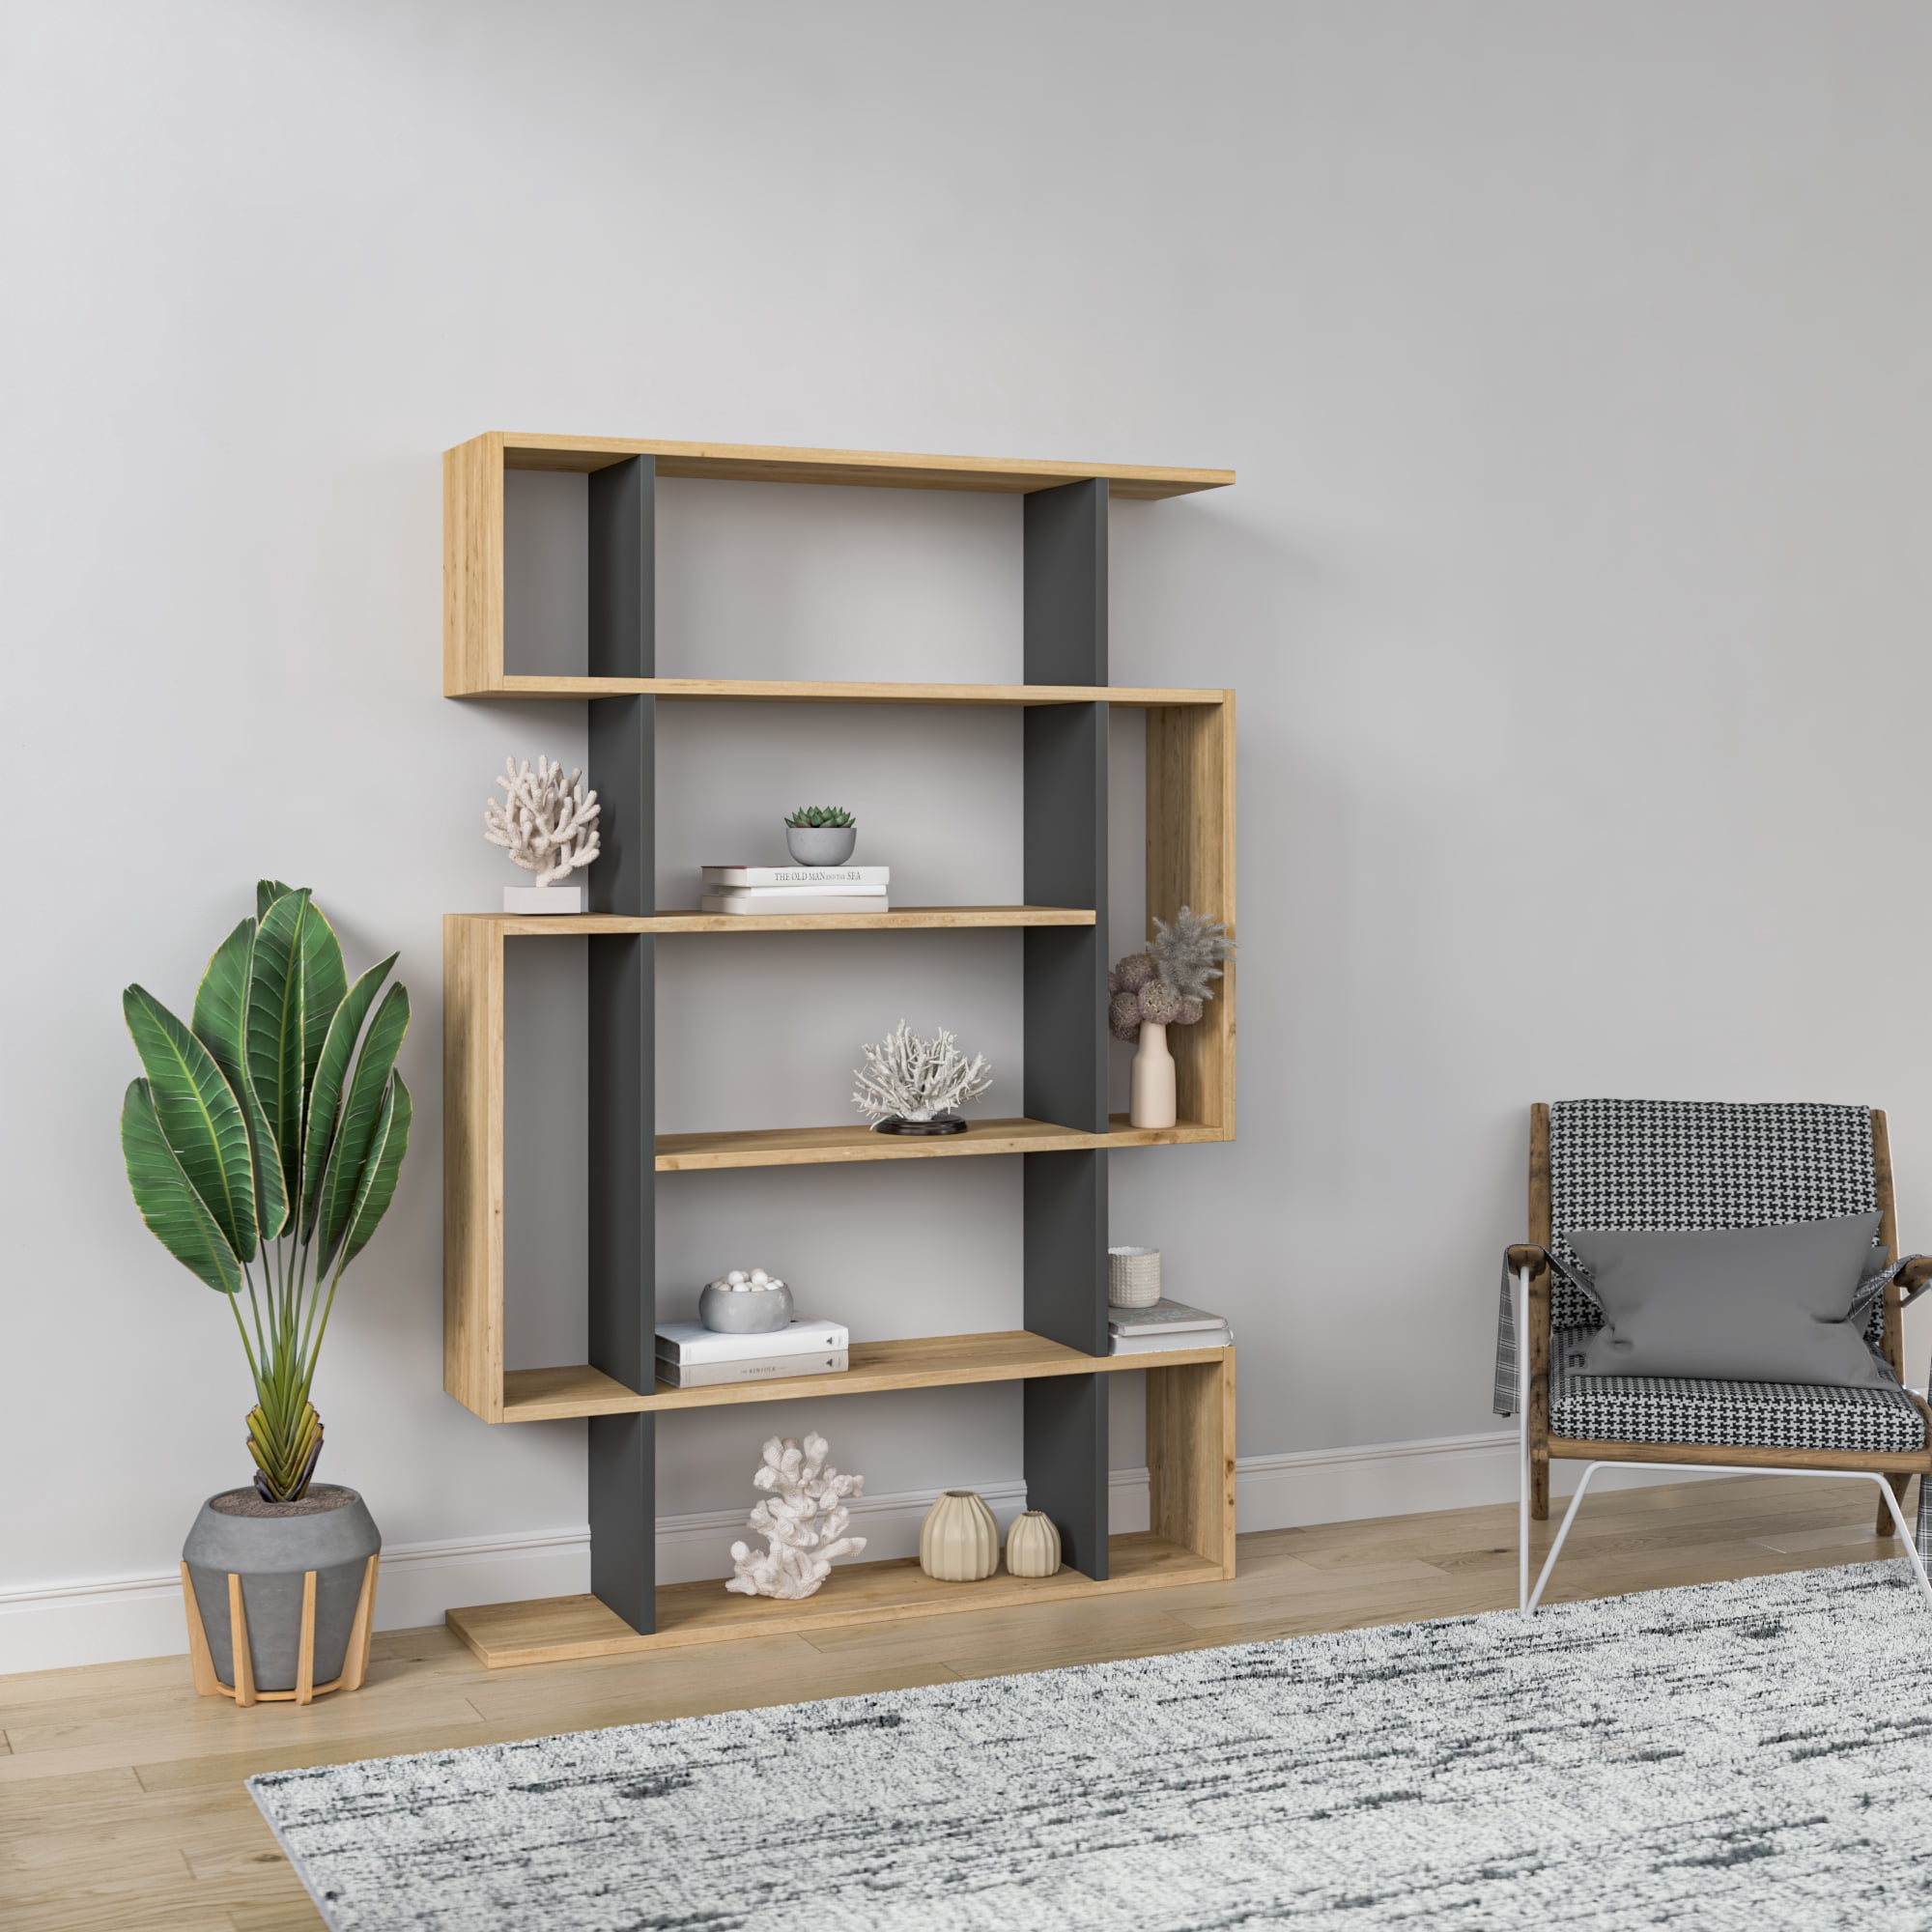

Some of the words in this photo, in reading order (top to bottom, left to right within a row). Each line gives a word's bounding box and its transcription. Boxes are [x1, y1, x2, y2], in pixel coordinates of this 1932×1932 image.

[775, 872, 790, 881] THE
[791, 871, 808, 881] OLD
[809, 871, 826, 881] MAN
[846, 871, 862, 880] SEA
